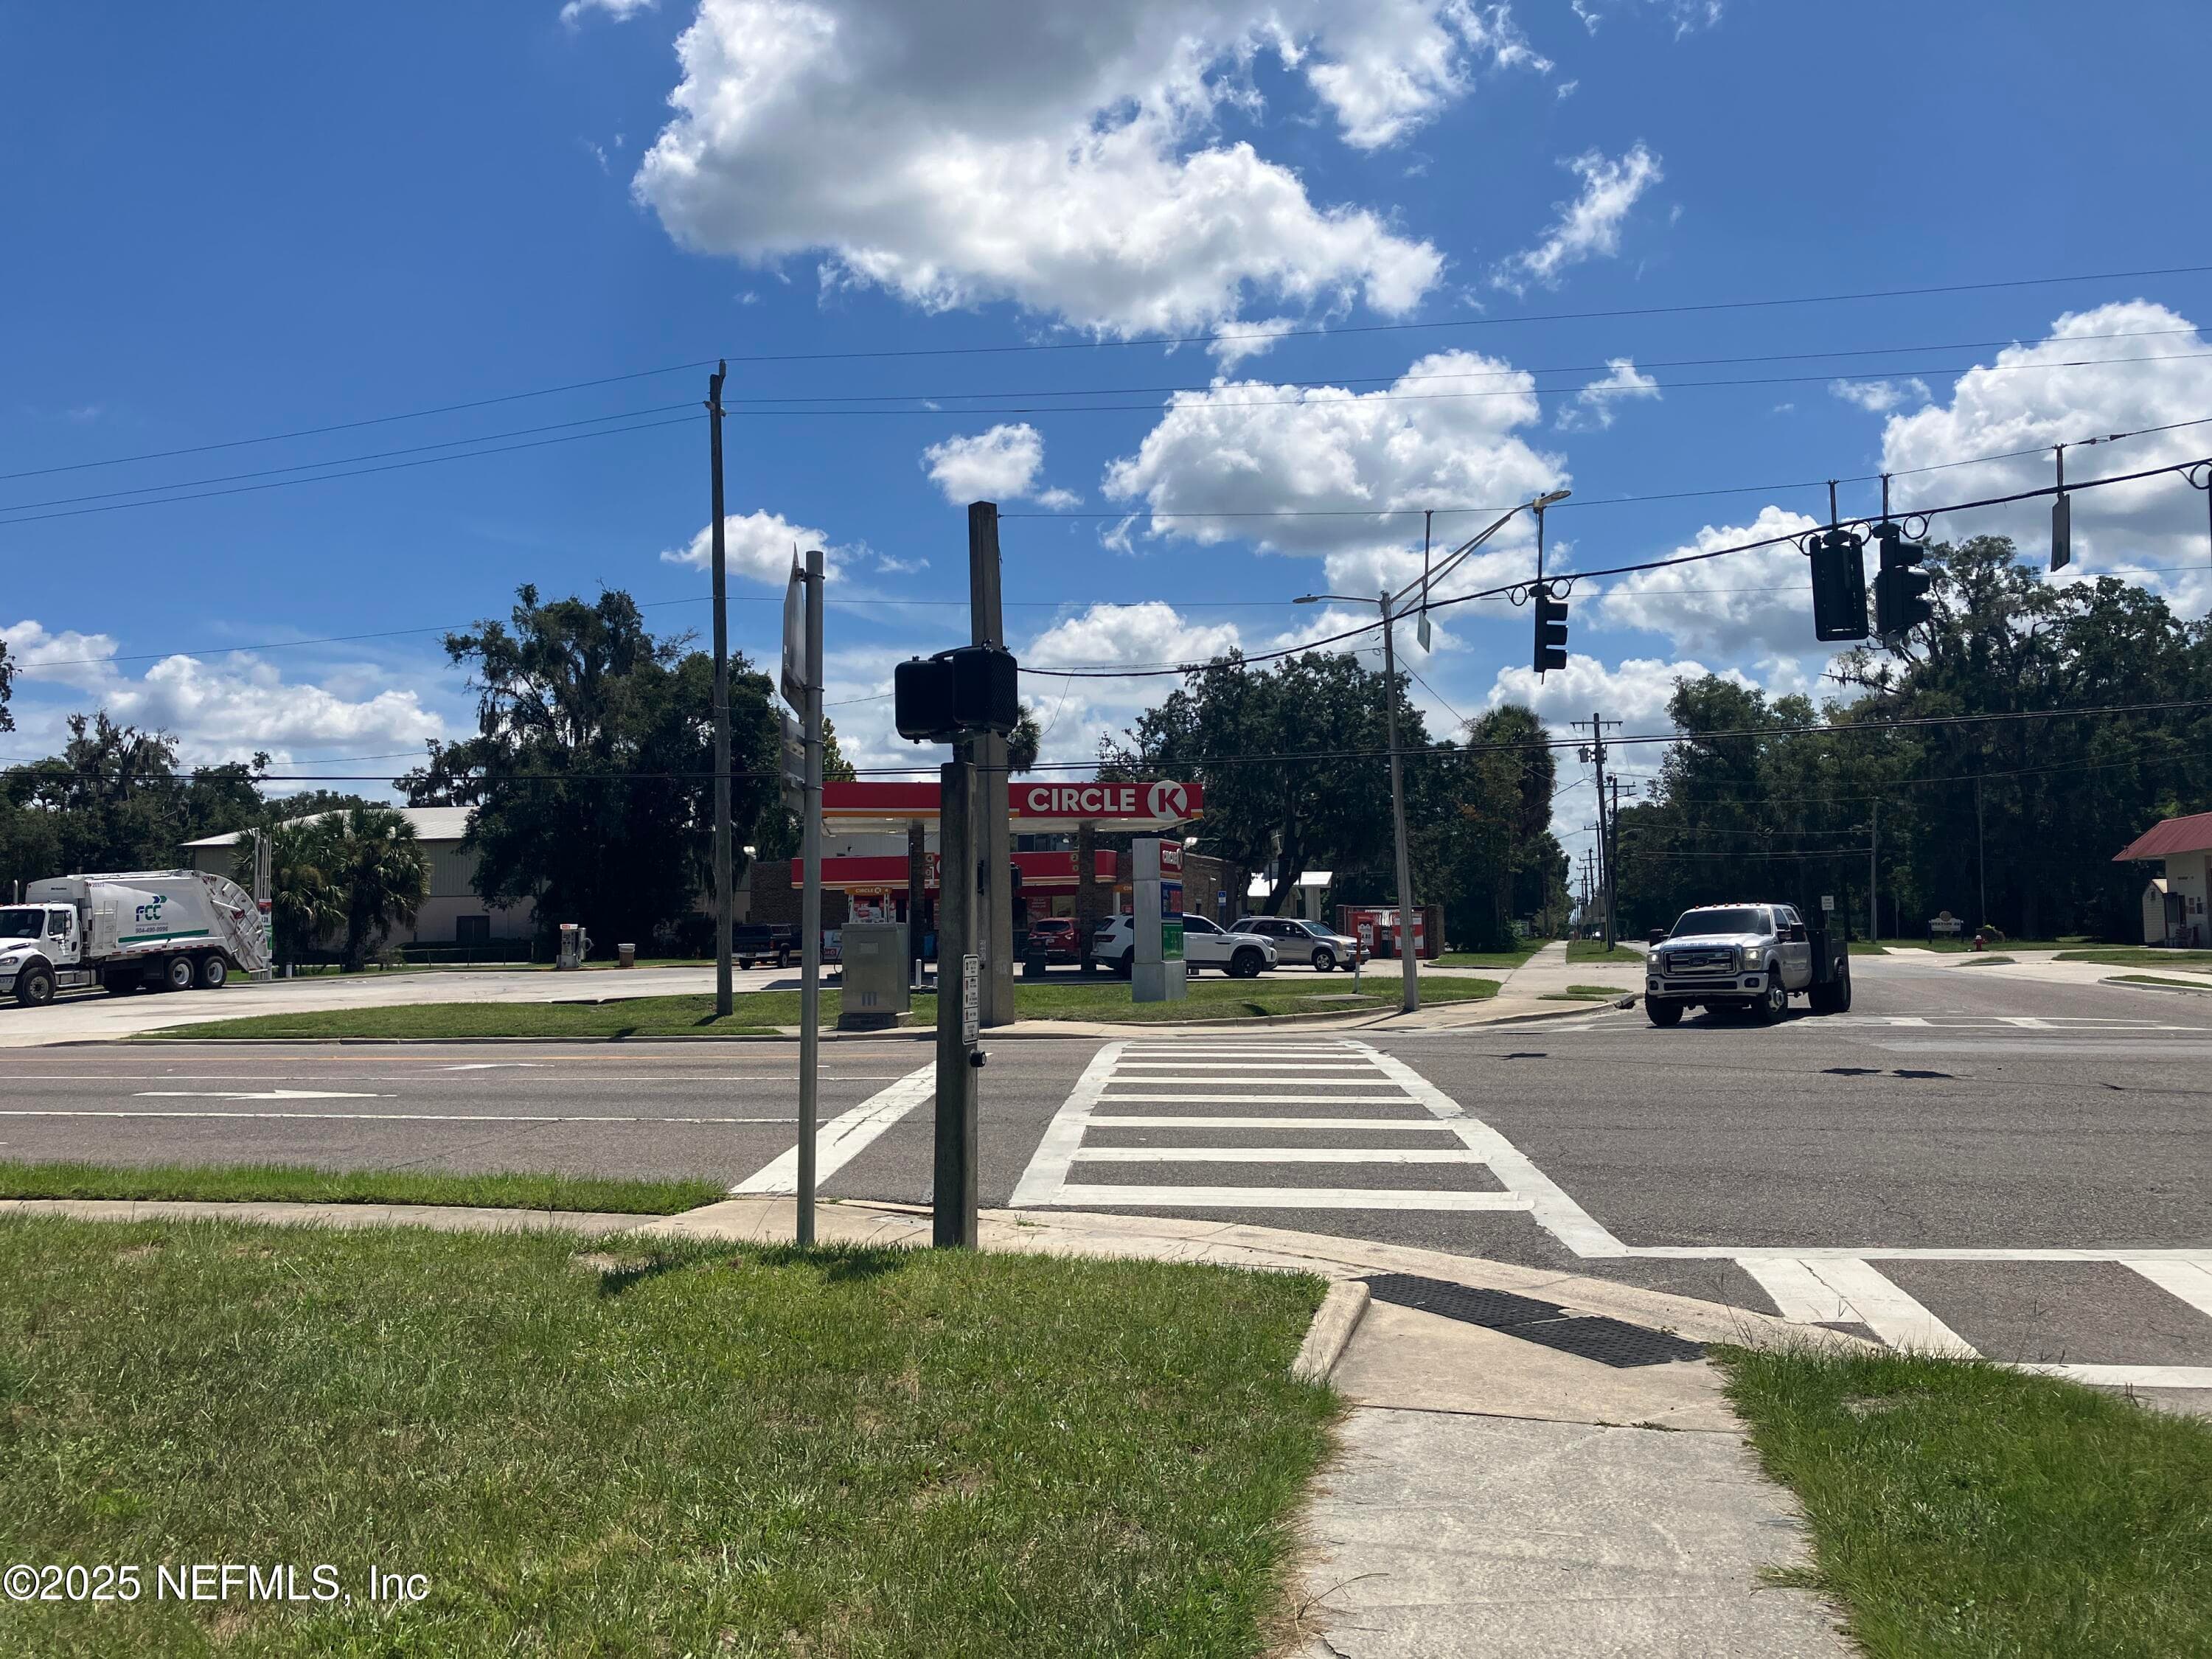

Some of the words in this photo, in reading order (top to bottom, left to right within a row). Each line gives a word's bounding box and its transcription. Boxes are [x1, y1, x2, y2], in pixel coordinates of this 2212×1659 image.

[1027, 787, 1136, 812] CIRCLE
[1154, 784, 1186, 820] K
[136, 904, 161, 922] FCC
